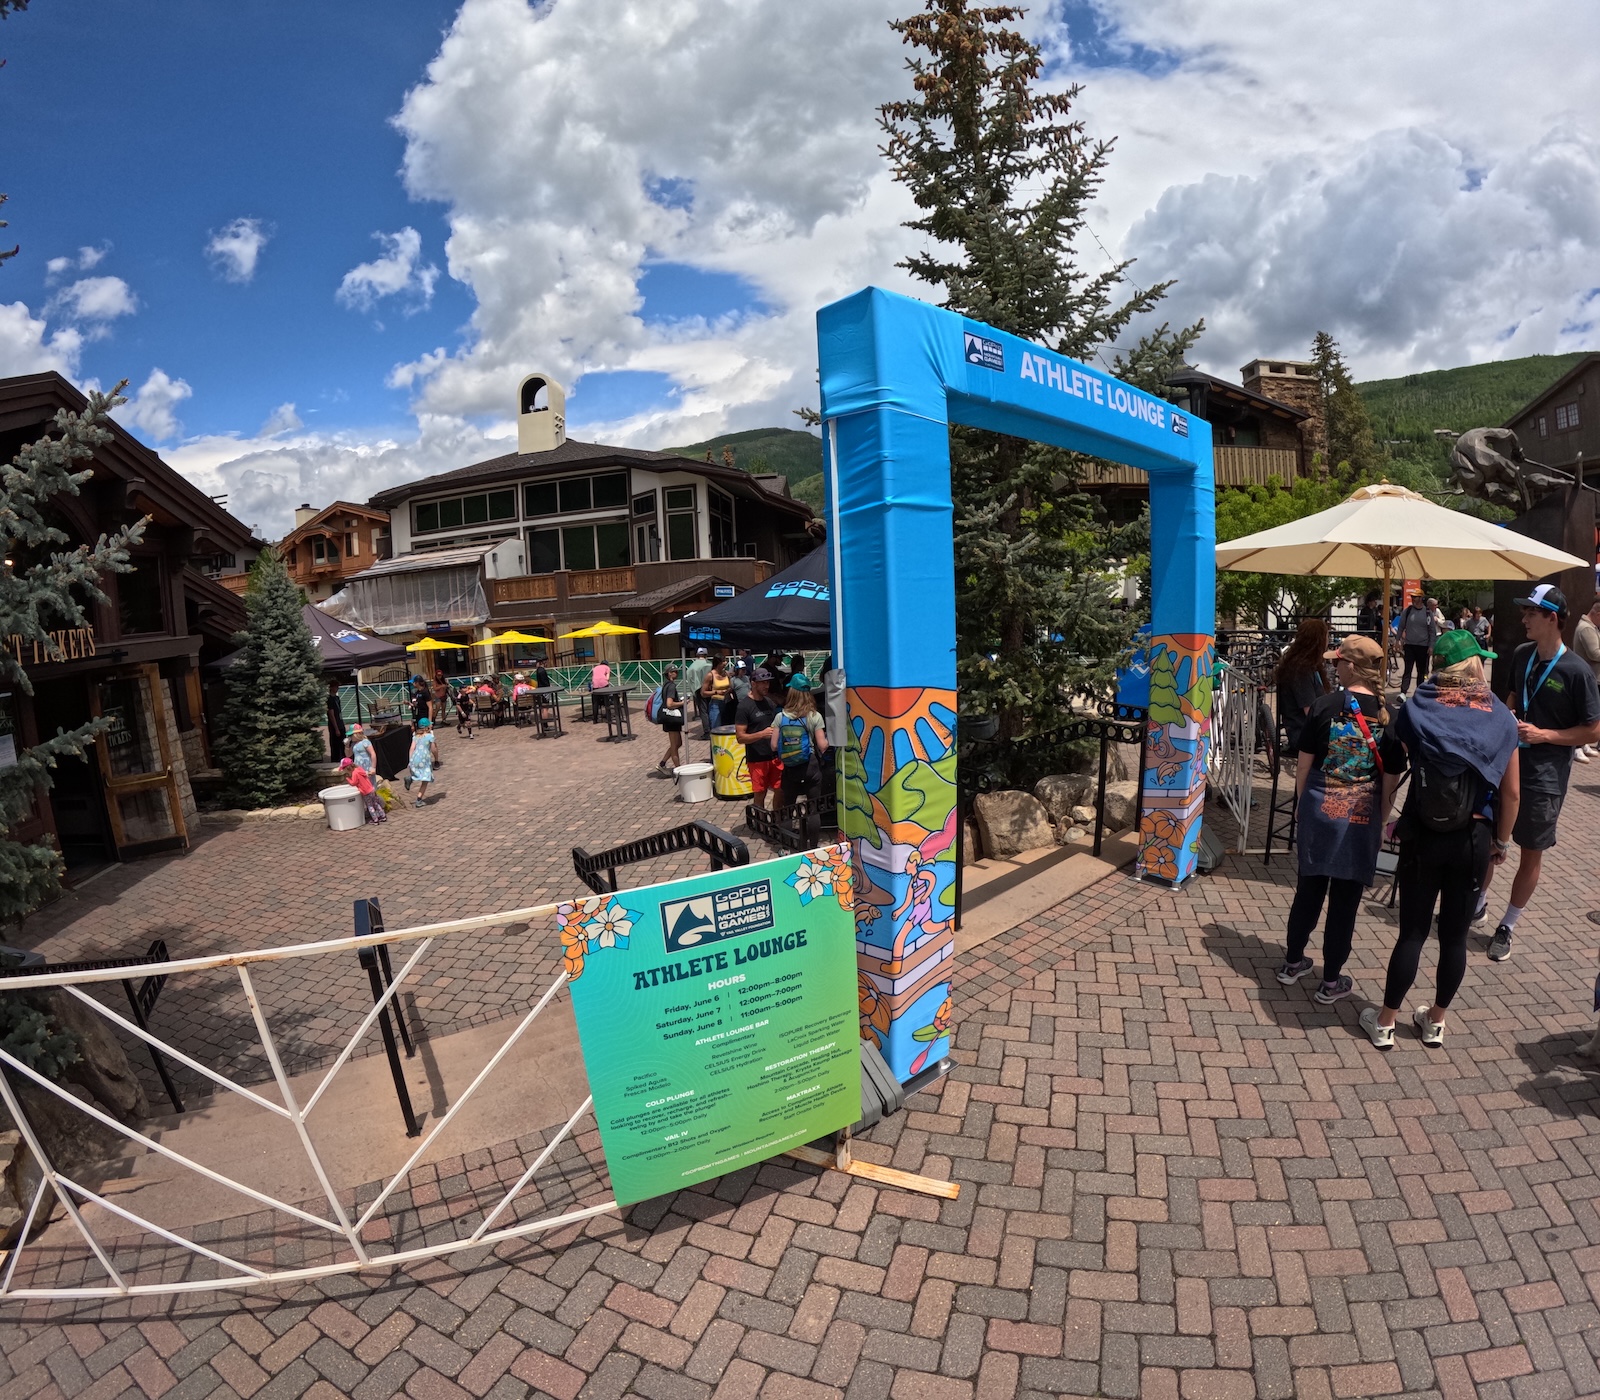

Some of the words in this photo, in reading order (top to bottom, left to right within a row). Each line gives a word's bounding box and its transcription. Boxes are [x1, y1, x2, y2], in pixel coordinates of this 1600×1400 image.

[1019, 351, 1104, 406] ATHLETE
[1107, 386, 1165, 430] LOUNGE
[689, 626, 720, 634] GoPro
[108, 730, 132, 747] TICKETS
[715, 885, 768, 903] GoPro
[718, 905, 765, 921] MOUNTAIN
[719, 912, 766, 930] GAMES
[748, 921, 771, 929] FOUNDATION
[633, 952, 728, 990] ATHLETE
[733, 929, 807, 965] LOUNGE
[708, 974, 746, 990] HOURS
[664, 1003, 692, 1014] Friday,
[693, 998, 712, 1008] June
[656, 1015, 694, 1029] Saturday,
[696, 1010, 714, 1020] June
[779, 1027, 803, 1038] ISOPURE
[805, 1019, 827, 1030] Recovery
[829, 1010, 852, 1021] Beverage
[663, 1027, 695, 1040] Sunday,
[697, 1022, 715, 1032] June
[695, 1033, 724, 1046] ATHLETE
[726, 1025, 754, 1036] LOUNGE
[755, 1019, 769, 1028] BAR
[788, 1033, 807, 1044] LaCroix
[832, 1019, 845, 1027] Water
[794, 1040, 809, 1048] Liquid
[810, 1035, 825, 1043] Death
[826, 1029, 840, 1037] Water
[712, 1033, 756, 1049] Complimentary
[704, 1059, 730, 1070] CELSIUS
[731, 1053, 750, 1063] Energy
[765, 1053, 808, 1071] RESTORATION
[809, 1042, 836, 1055] THERAPY
[710, 1065, 735, 1076] CELSIUS
[736, 1056, 763, 1068] Hydration
[747, 1080, 769, 1090] Hoshino
[796, 1065, 812, 1073] Krysta
[831, 1049, 852, 1059] Massage
[760, 1070, 785, 1080] Mountain
[811, 1053, 830, 1062] Healing
[788, 1067, 820, 1080] Acupuncture
[626, 1082, 647, 1091] Spiked
[648, 1077, 668, 1086] Aguas
[633, 1071, 657, 1081] Pacifico
[624, 1089, 647, 1098] Frescas
[648, 1082, 671, 1091] Modelo
[645, 1098, 665, 1108] COLD
[666, 1090, 695, 1102] PLUNGE
[786, 1084, 821, 1101] MAXTRAXX
[626, 1111, 650, 1122] plunges
[663, 1100, 689, 1111] available
[708, 1088, 730, 1098] athletes
[759, 1112, 783, 1123] Recovery
[795, 1100, 812, 1109] Muscle
[813, 1093, 829, 1102] Health
[831, 1087, 846, 1095] Device
[762, 1108, 780, 1117] Access
[788, 1091, 825, 1108] Complimentary
[826, 1083, 843, 1092] Athlete
[610, 1121, 633, 1130] looking
[642, 1112, 666, 1122] recover,
[667, 1105, 694, 1116] recharge,
[629, 1123, 648, 1131] swing
[670, 1112, 683, 1120] take
[695, 1103, 716, 1114] plunge!
[693, 1113, 708, 1121] Daily
[796, 1107, 812, 1115] Onsite
[622, 1146, 666, 1160] Complimentary
[680, 1135, 696, 1143] Shots
[710, 1125, 731, 1135] Oxygen
[681, 1154, 740, 1176] #GOPROMTNGAMES
[744, 1129, 807, 1155] MOUNTAINGAMES.COM
